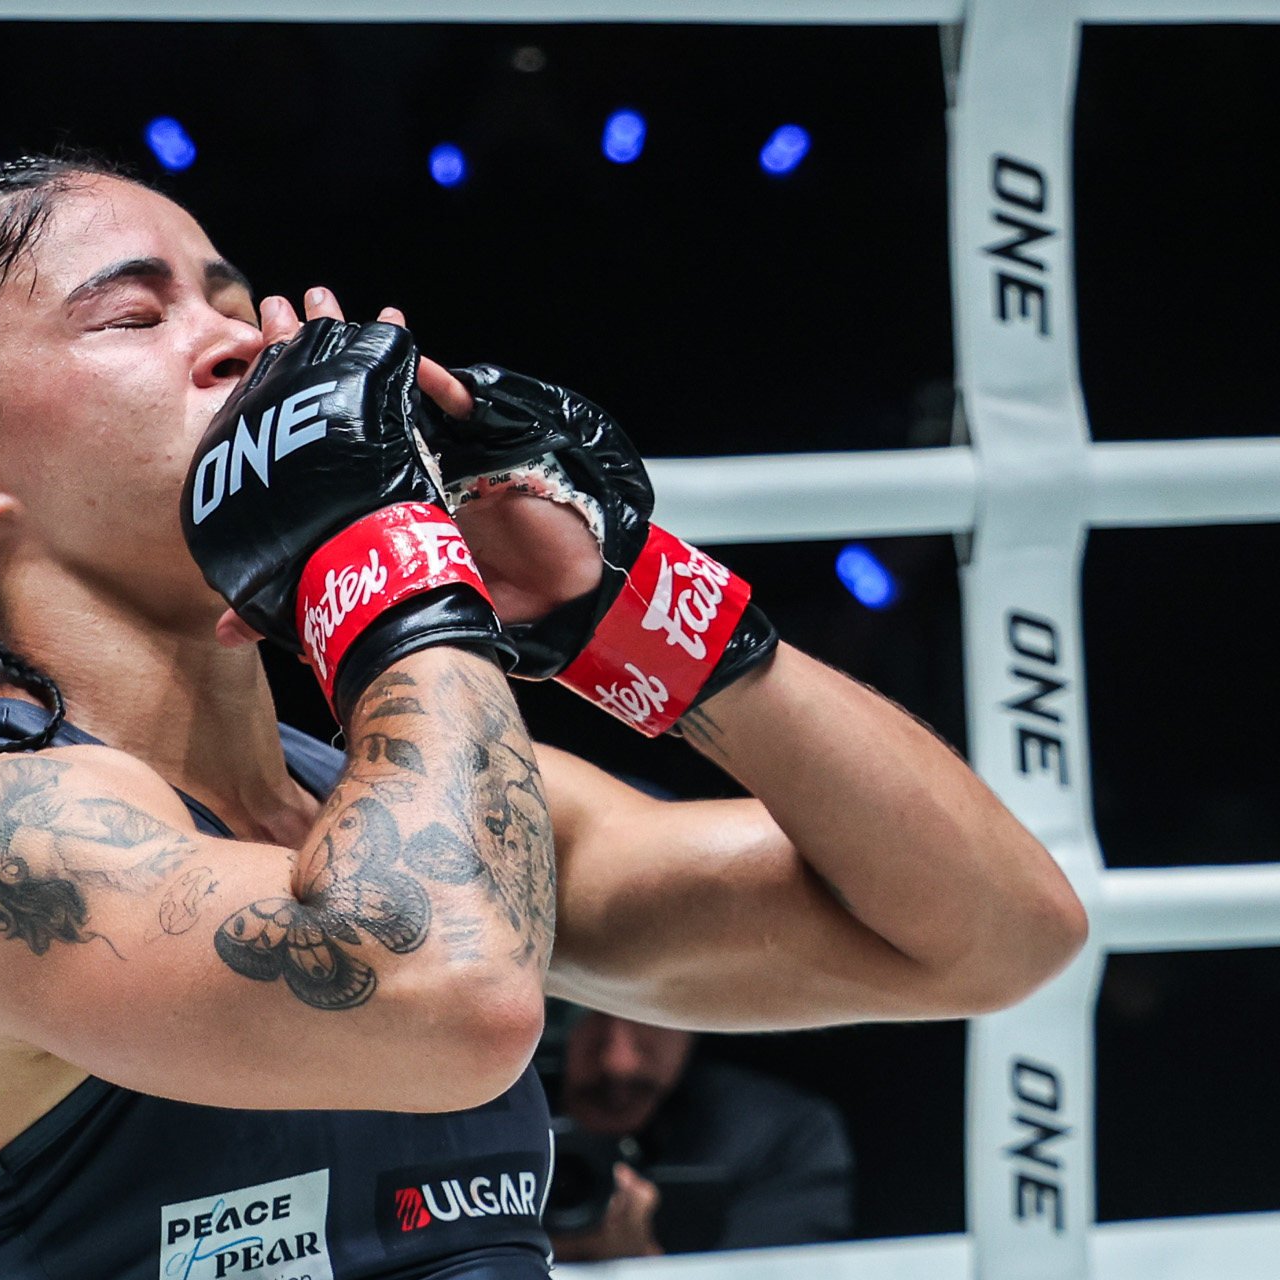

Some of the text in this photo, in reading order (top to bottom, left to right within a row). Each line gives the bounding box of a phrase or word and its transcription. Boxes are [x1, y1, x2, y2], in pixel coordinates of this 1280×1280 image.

[981, 152, 1056, 339] ONE
[193, 381, 338, 525] ONE
[1001, 607, 1069, 787] ONE
[167, 1194, 291, 1245] PEACE
[1001, 1055, 1070, 1235] ONE
[215, 1231, 322, 1279] PEAR
